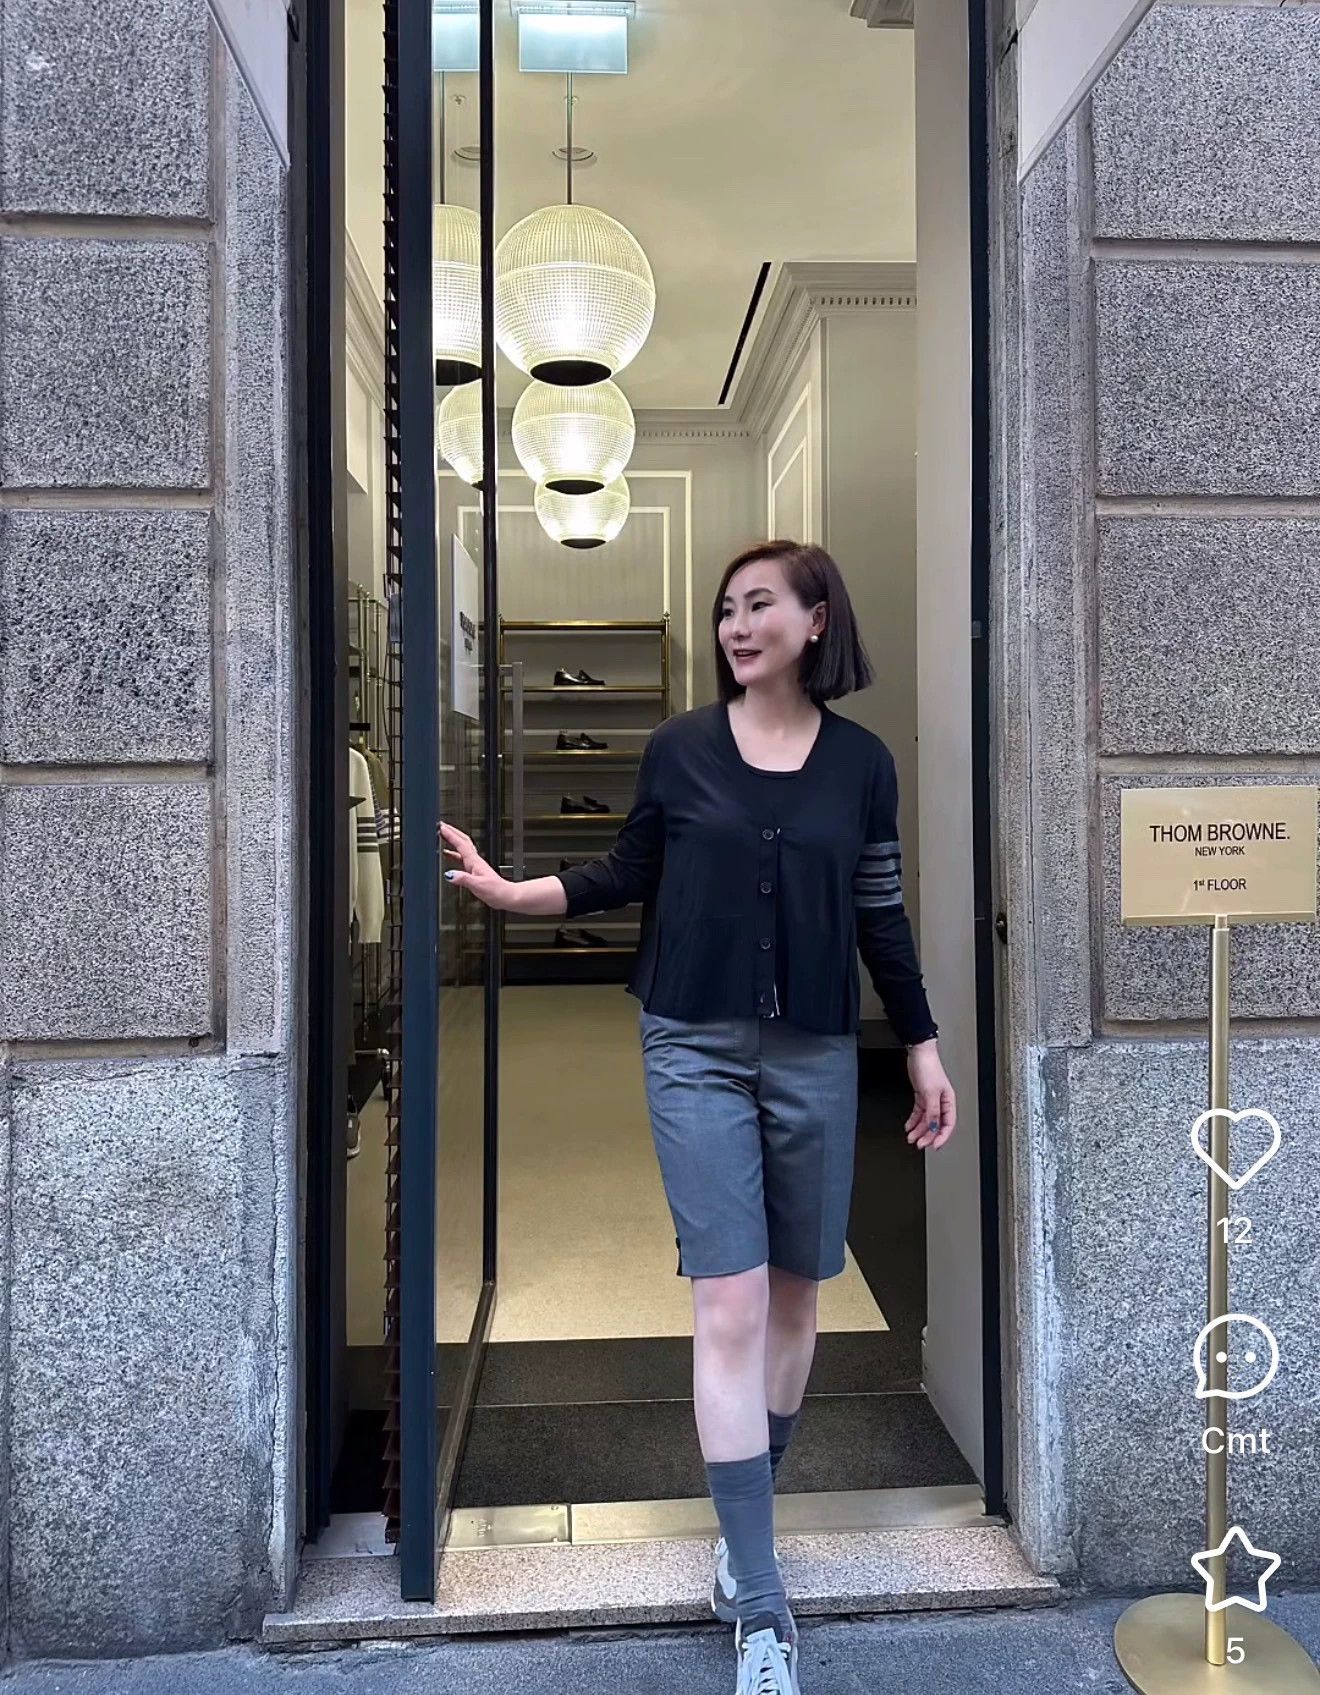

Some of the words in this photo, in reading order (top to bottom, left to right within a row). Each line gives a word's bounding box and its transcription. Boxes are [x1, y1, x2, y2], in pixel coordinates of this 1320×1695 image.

[1150, 824, 1201, 842] THOM
[1207, 822, 1291, 841] BROWNE.
[1195, 847, 1217, 856] NEW
[1219, 846, 1245, 856] YORK
[1193, 880, 1205, 891] 1st
[1207, 878, 1247, 891] FLOOR
